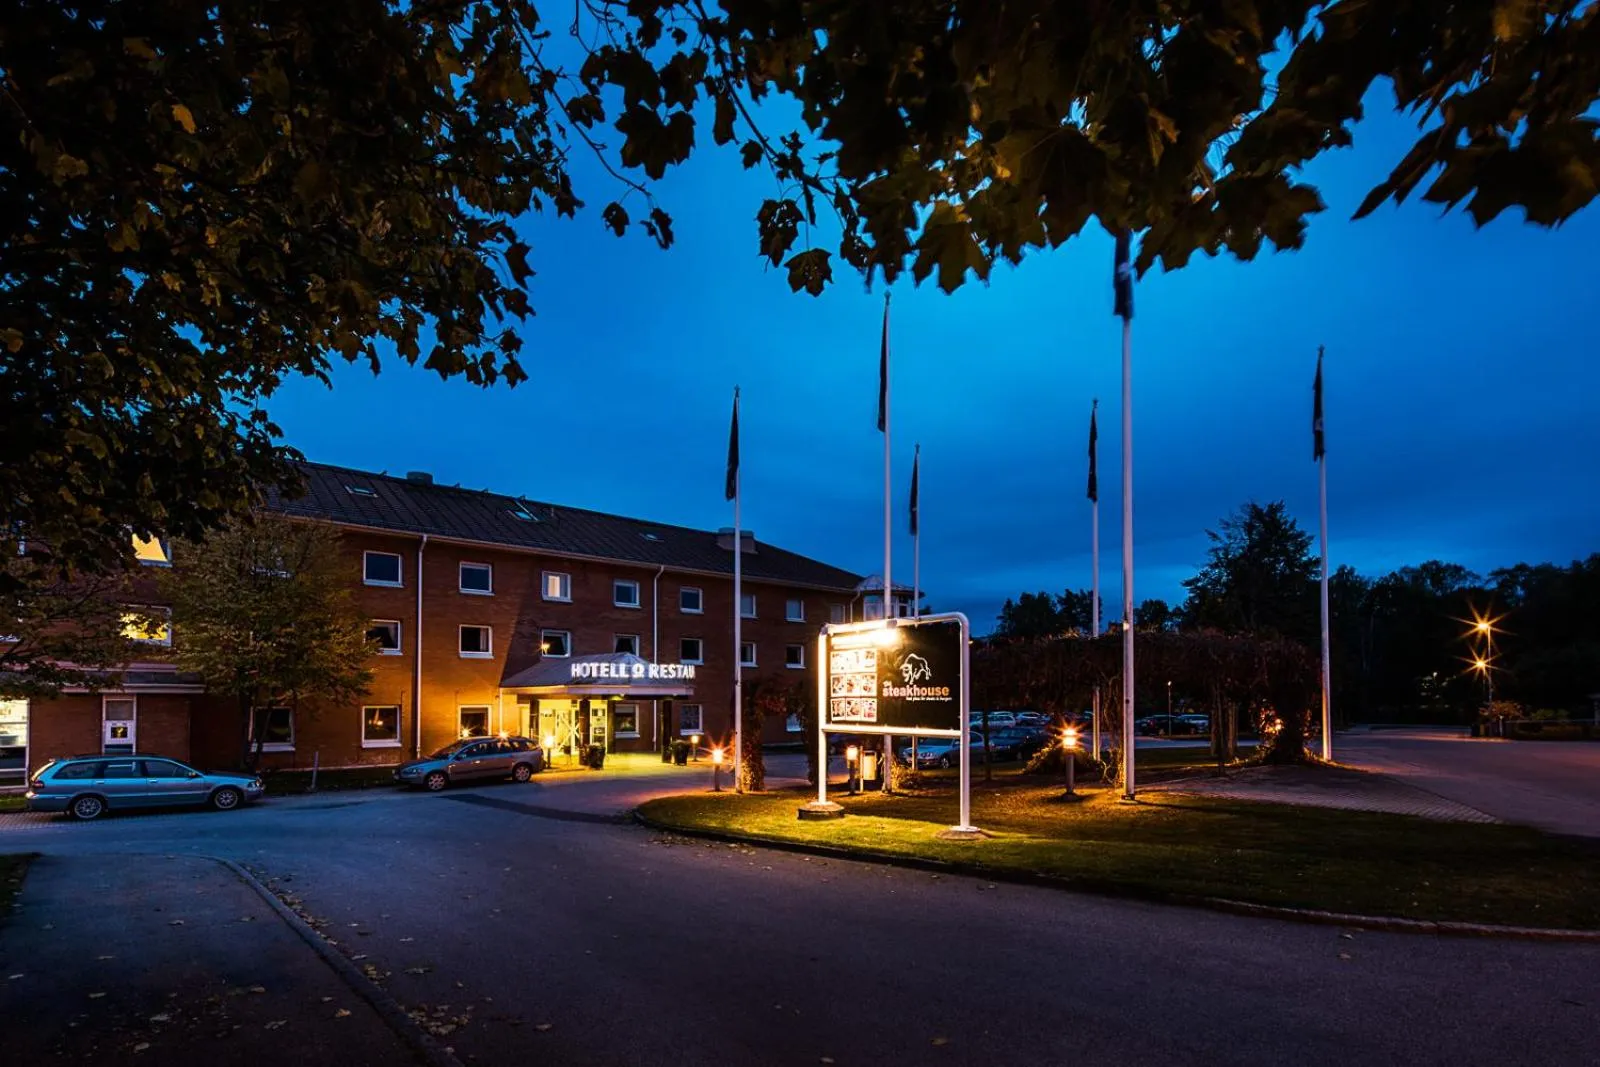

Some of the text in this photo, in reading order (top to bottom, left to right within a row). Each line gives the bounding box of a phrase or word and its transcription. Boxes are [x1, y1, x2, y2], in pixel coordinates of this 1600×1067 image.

[571, 662, 630, 678] HOTELL
[648, 663, 696, 679] RESTAU
[882, 684, 950, 697] steakhouse
